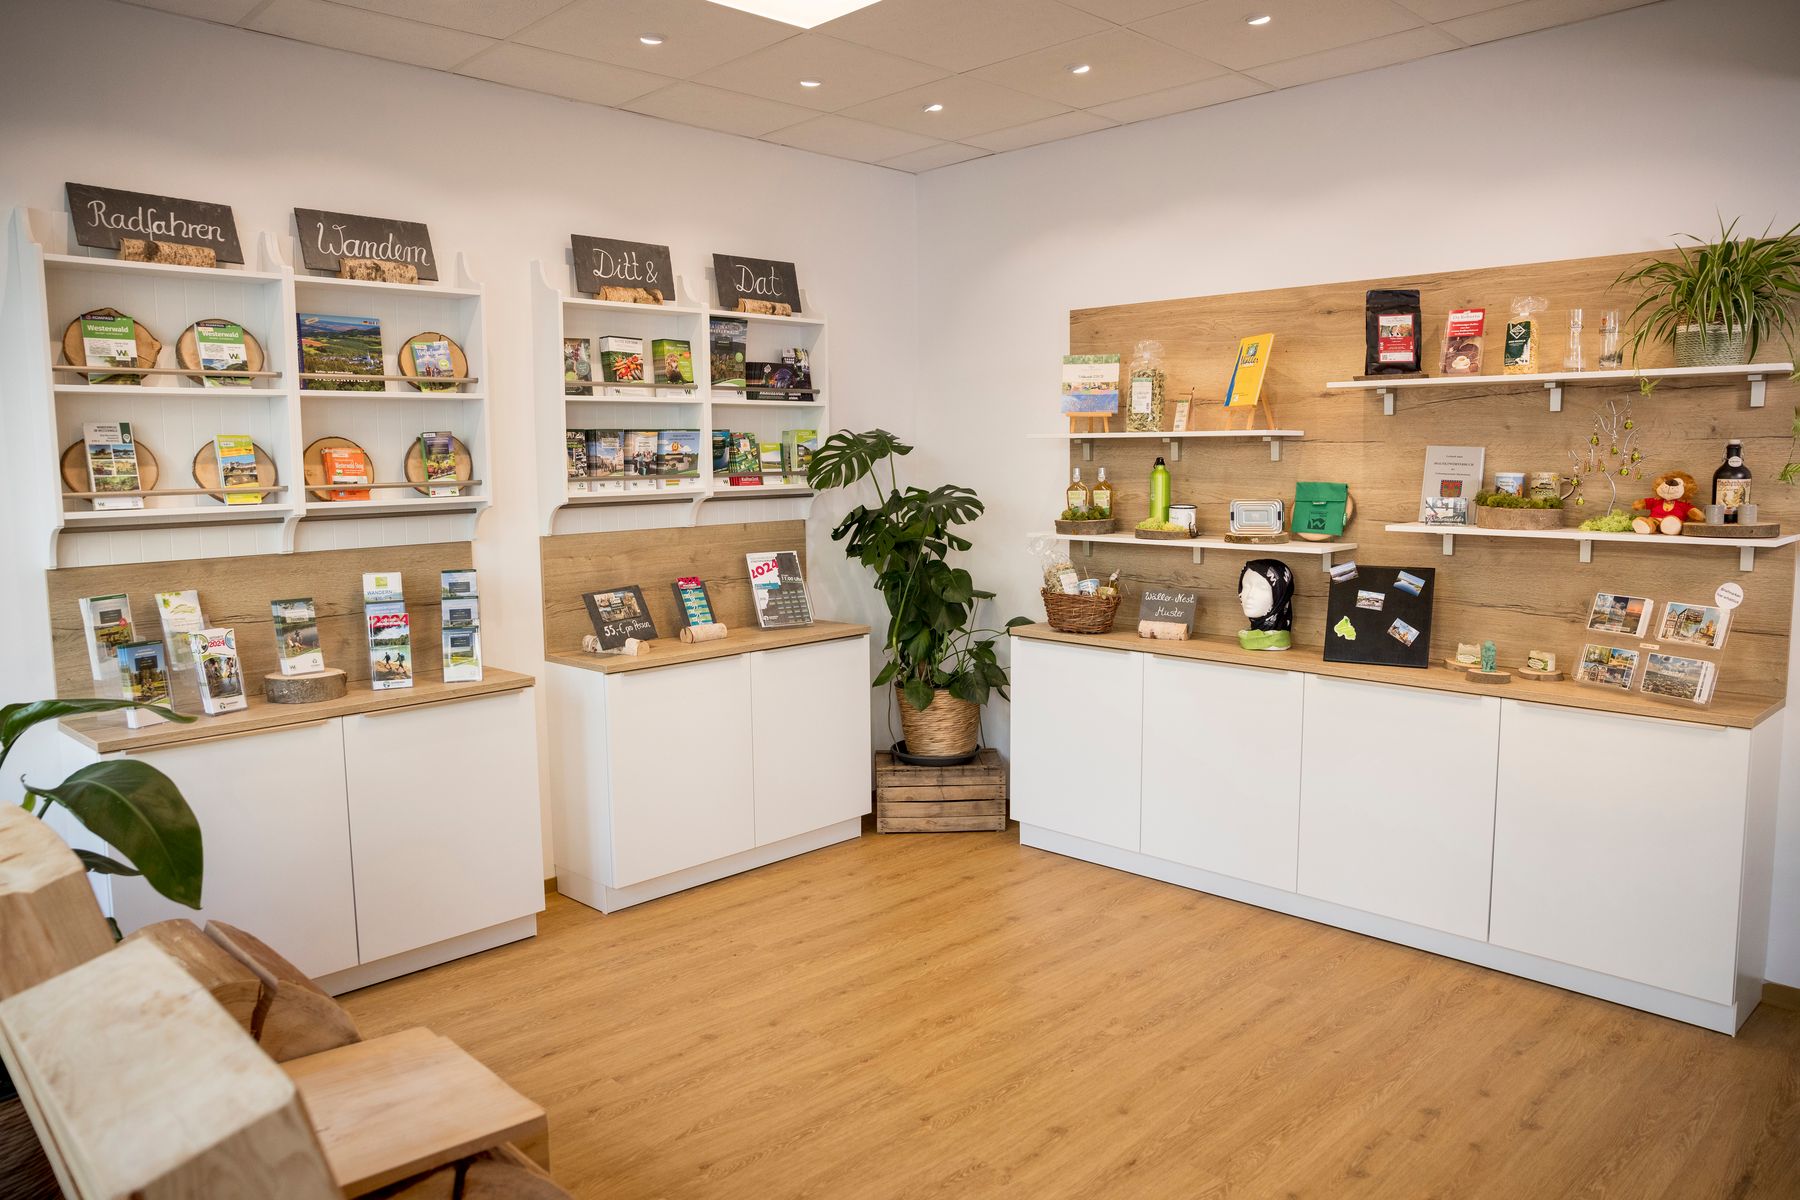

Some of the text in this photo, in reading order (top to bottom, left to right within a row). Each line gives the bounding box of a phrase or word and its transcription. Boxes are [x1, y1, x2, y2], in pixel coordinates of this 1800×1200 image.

[86, 200, 226, 241] Radfahren
[316, 222, 430, 267] Wandern
[592, 248, 658, 284] Ditt &
[735, 264, 783, 296] Dat
[86, 324, 129, 334] Westerwald
[1154, 606, 1185, 618] Muster
[208, 639, 225, 648] 2024
